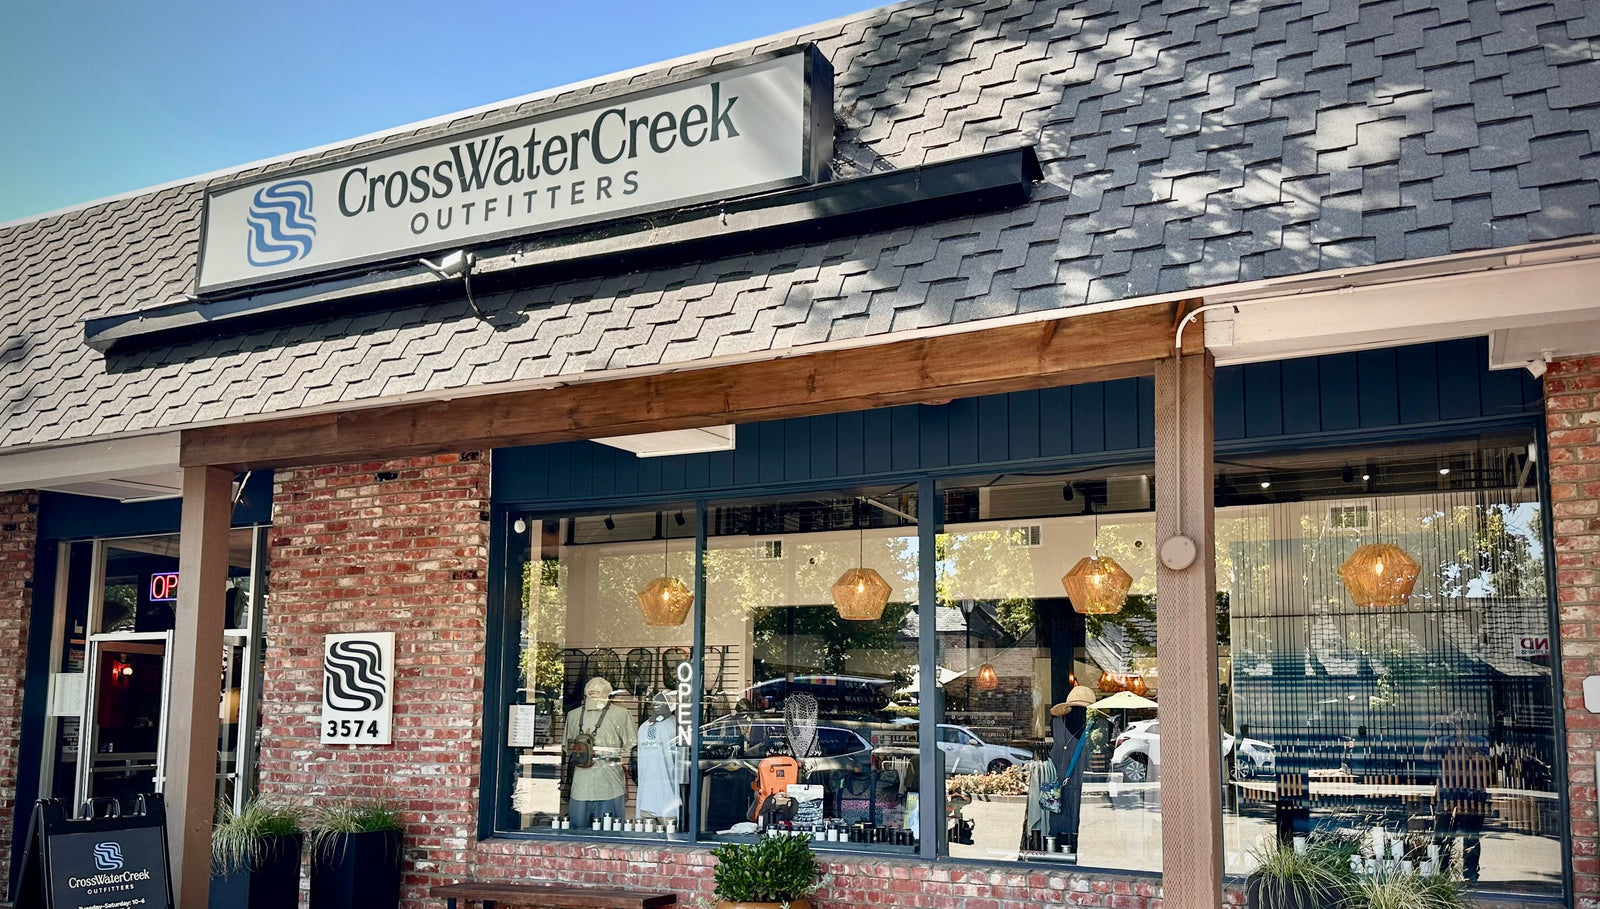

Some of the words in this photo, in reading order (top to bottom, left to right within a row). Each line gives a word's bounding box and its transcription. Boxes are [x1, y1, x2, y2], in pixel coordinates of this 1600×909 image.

[339, 82, 741, 217] CrossWaterCreek
[410, 170, 639, 235] OUTFITTERS
[152, 574, 178, 599] OP
[677, 661, 693, 746] OPEN
[326, 720, 379, 738] 3574
[68, 869, 151, 889] CrossWaterCreek
[87, 883, 135, 895] OUTFITTERS
